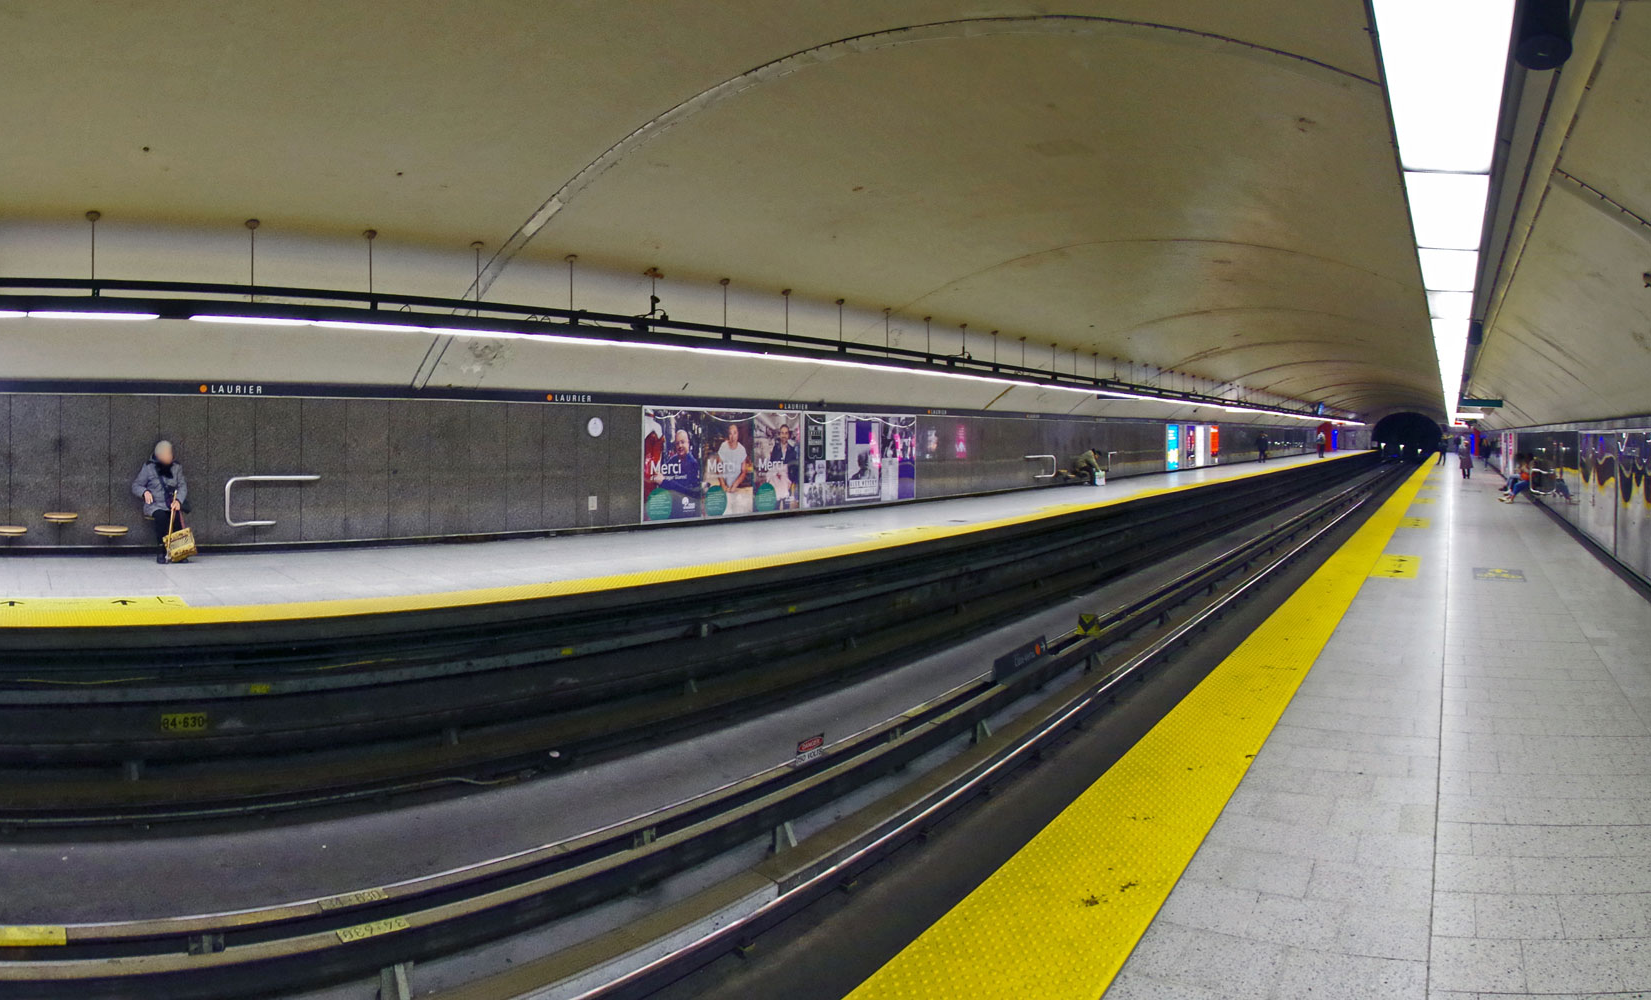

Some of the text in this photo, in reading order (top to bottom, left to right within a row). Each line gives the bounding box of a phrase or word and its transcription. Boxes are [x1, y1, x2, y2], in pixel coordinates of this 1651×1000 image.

[211, 384, 262, 394] LAURIER
[554, 394, 591, 403] LAURIER
[650, 459, 682, 475] Merci
[707, 459, 734, 475] Merci
[758, 458, 784, 472] Merci
[802, 737, 821, 749] DANGER
